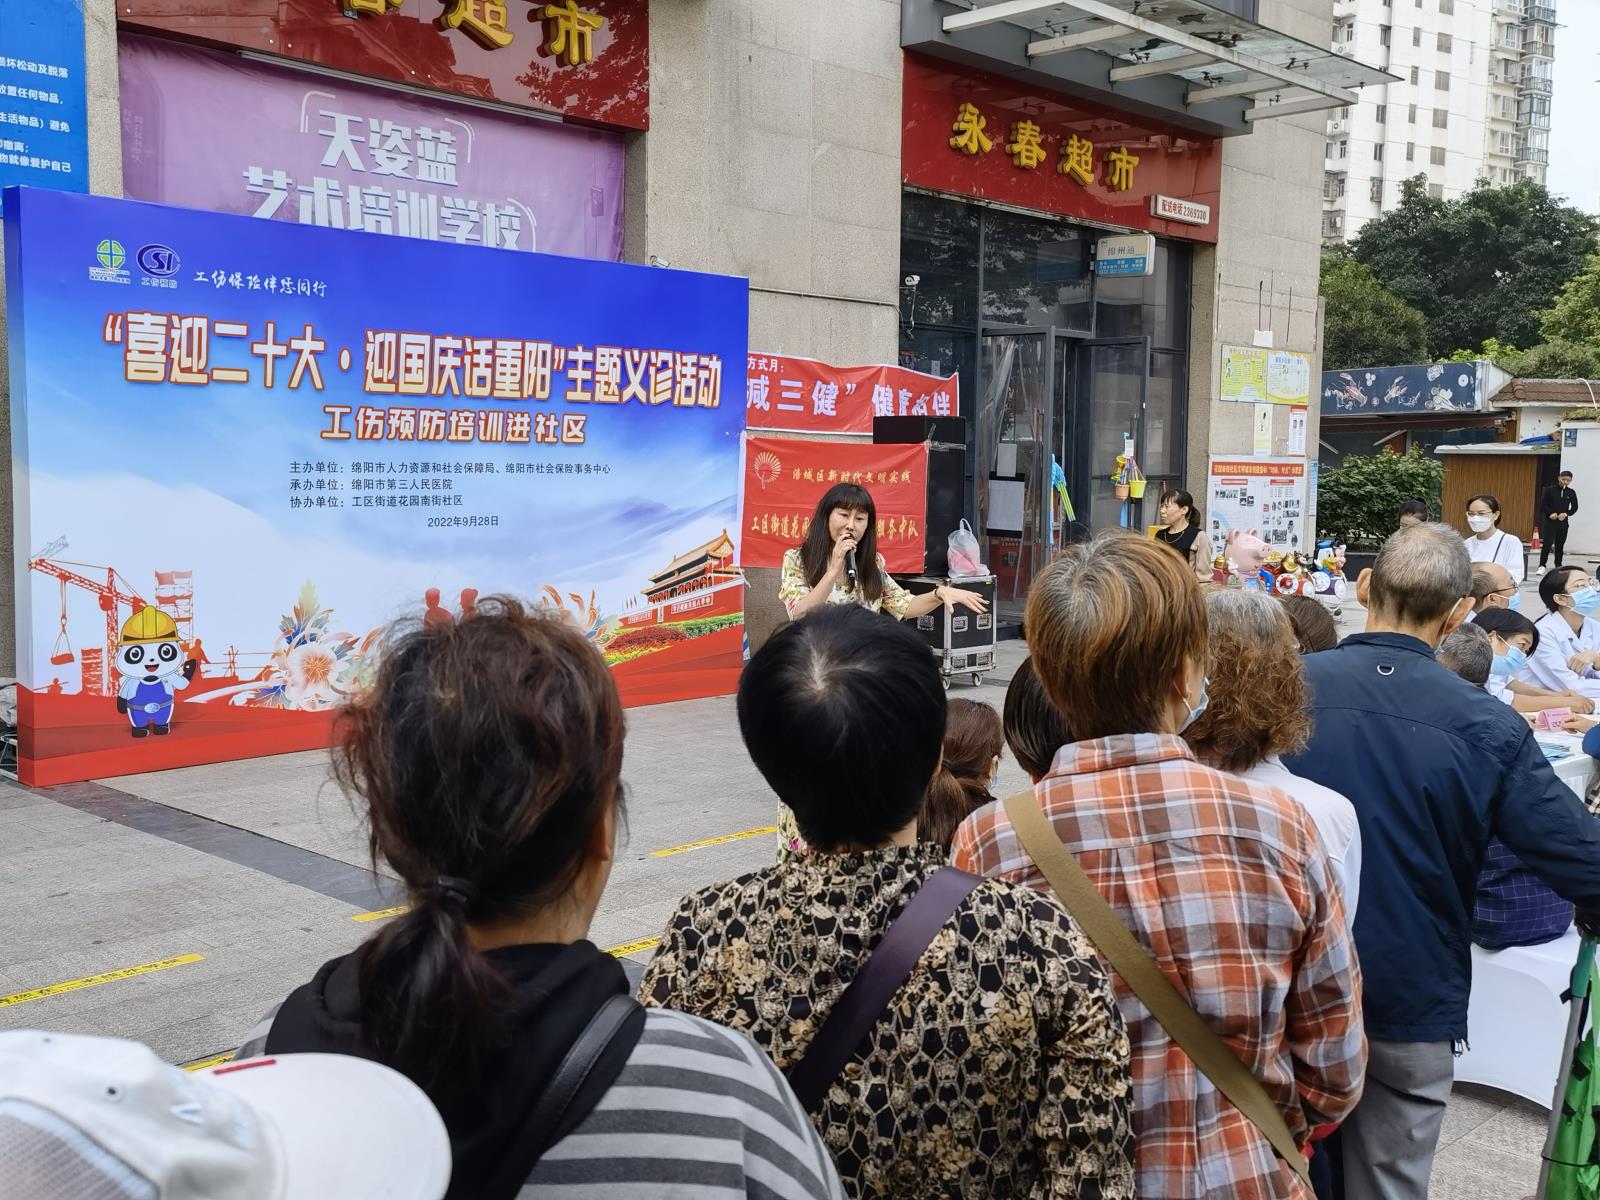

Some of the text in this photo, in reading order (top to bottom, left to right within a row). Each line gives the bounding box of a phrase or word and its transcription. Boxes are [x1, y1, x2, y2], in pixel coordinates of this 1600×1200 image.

[318, 110, 459, 187] 天姿蓝
[950, 101, 1140, 192] 永春超市
[242, 165, 521, 251] 艺术培训学校
[193, 269, 328, 298] 工伤保险伴您同行
[320, 404, 588, 444] 工伤预防培训进社区
[427, 515, 499, 528] 2022年9月28日
